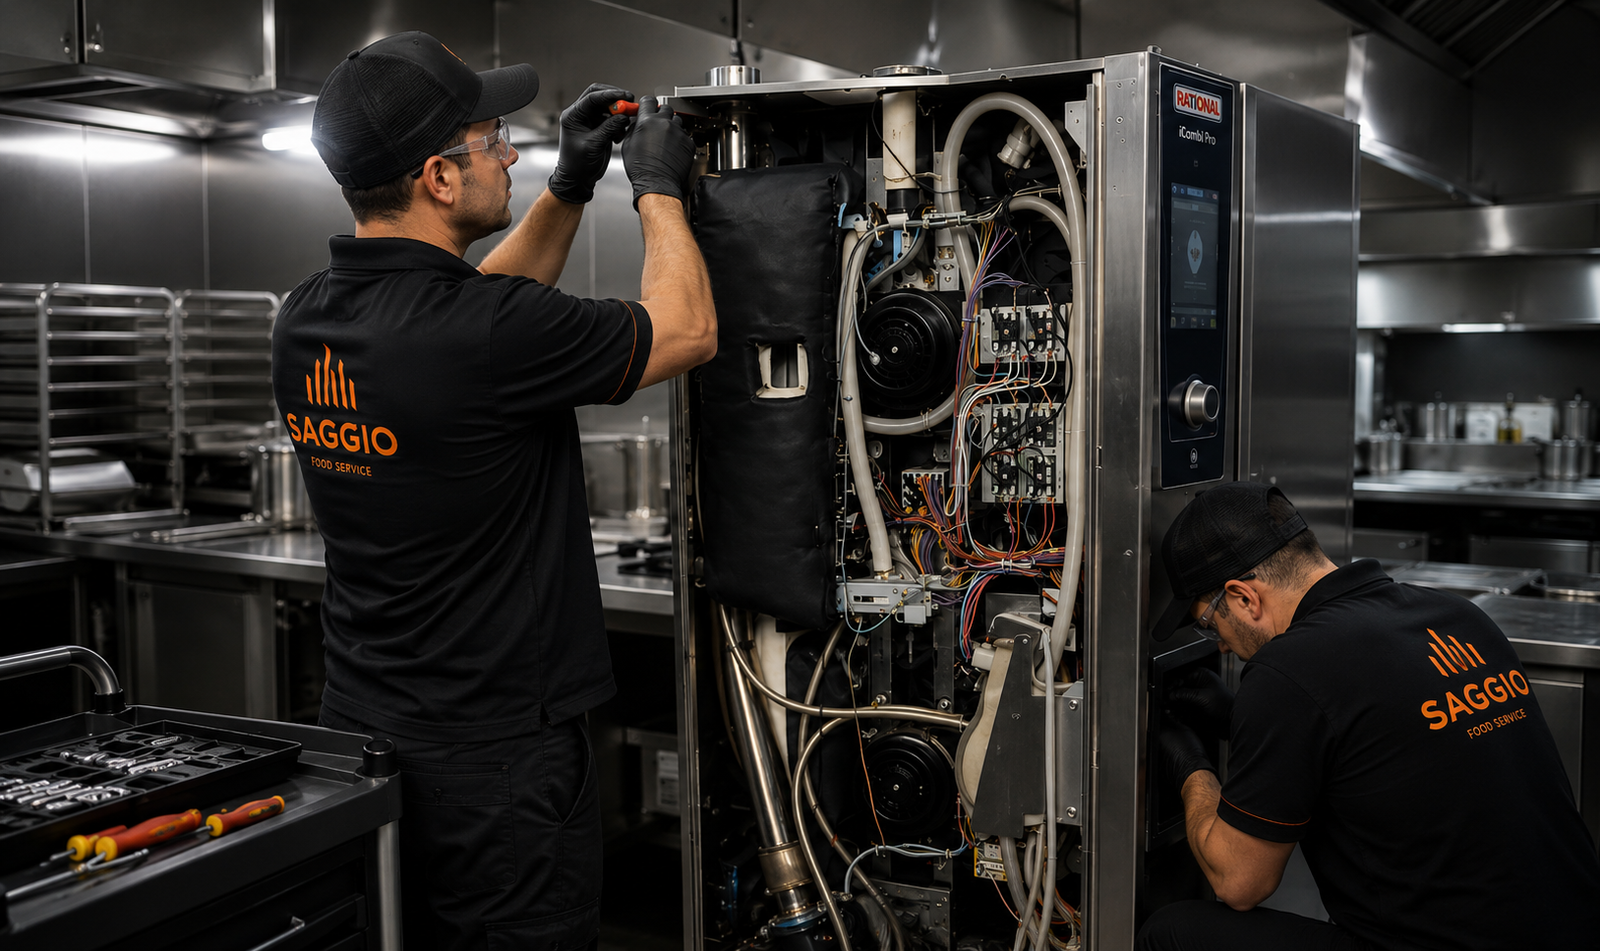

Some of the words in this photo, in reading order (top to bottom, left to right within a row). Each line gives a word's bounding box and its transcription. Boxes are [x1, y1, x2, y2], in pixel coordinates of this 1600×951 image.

[1177, 90, 1220, 116] RATIONAL
[1179, 126, 1204, 142] iCombi
[1205, 132, 1216, 146] Pro
[287, 413, 398, 456] SAGGIO
[311, 456, 333, 470] FOOD
[335, 462, 372, 477] SERVICE
[1421, 669, 1530, 730] SAGGIO
[1467, 721, 1494, 739] FOOD
[1493, 708, 1527, 728] SERVICE
